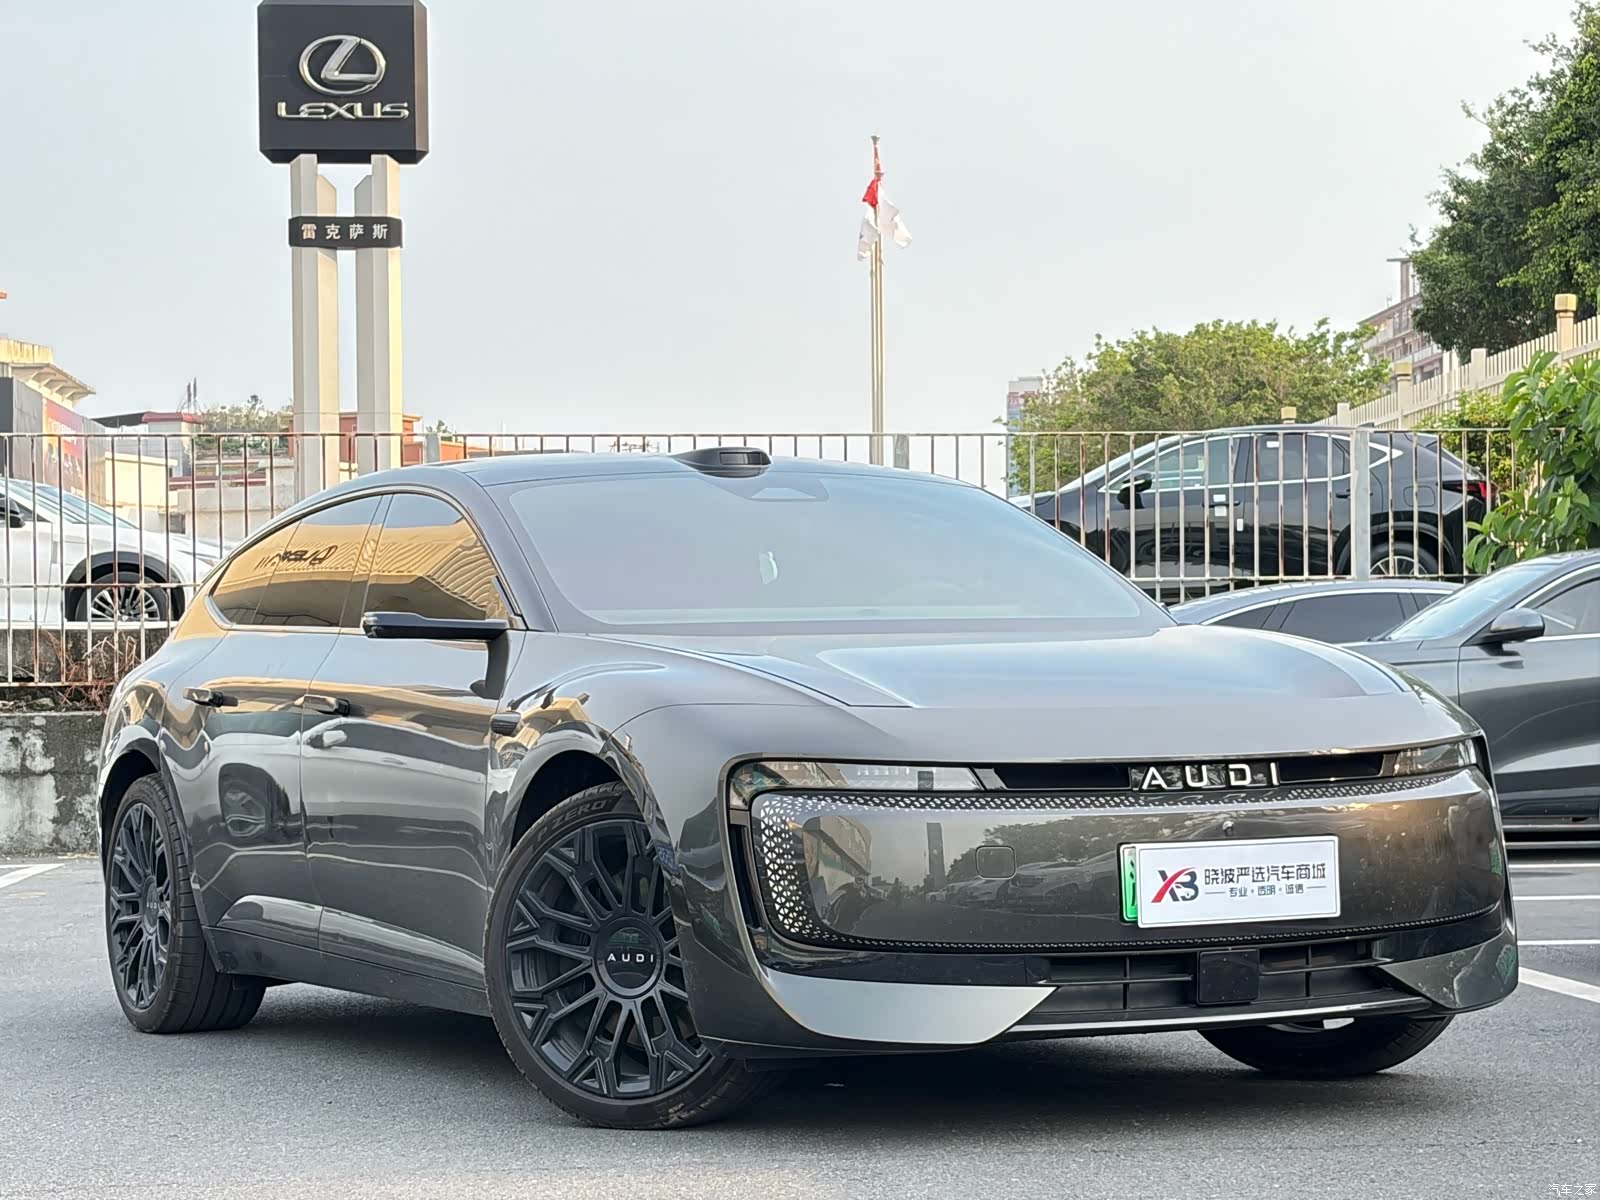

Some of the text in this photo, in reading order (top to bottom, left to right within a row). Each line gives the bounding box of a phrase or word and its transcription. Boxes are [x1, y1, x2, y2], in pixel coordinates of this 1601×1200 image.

[277, 102, 409, 119] LEXUS
[301, 223, 388, 240] 雷克萨斯
[1141, 761, 1279, 790] AUDI
[551, 800, 607, 830] ZERO
[1204, 863, 1326, 885] 晓波严选汽车商城
[607, 953, 654, 963] AUDI
